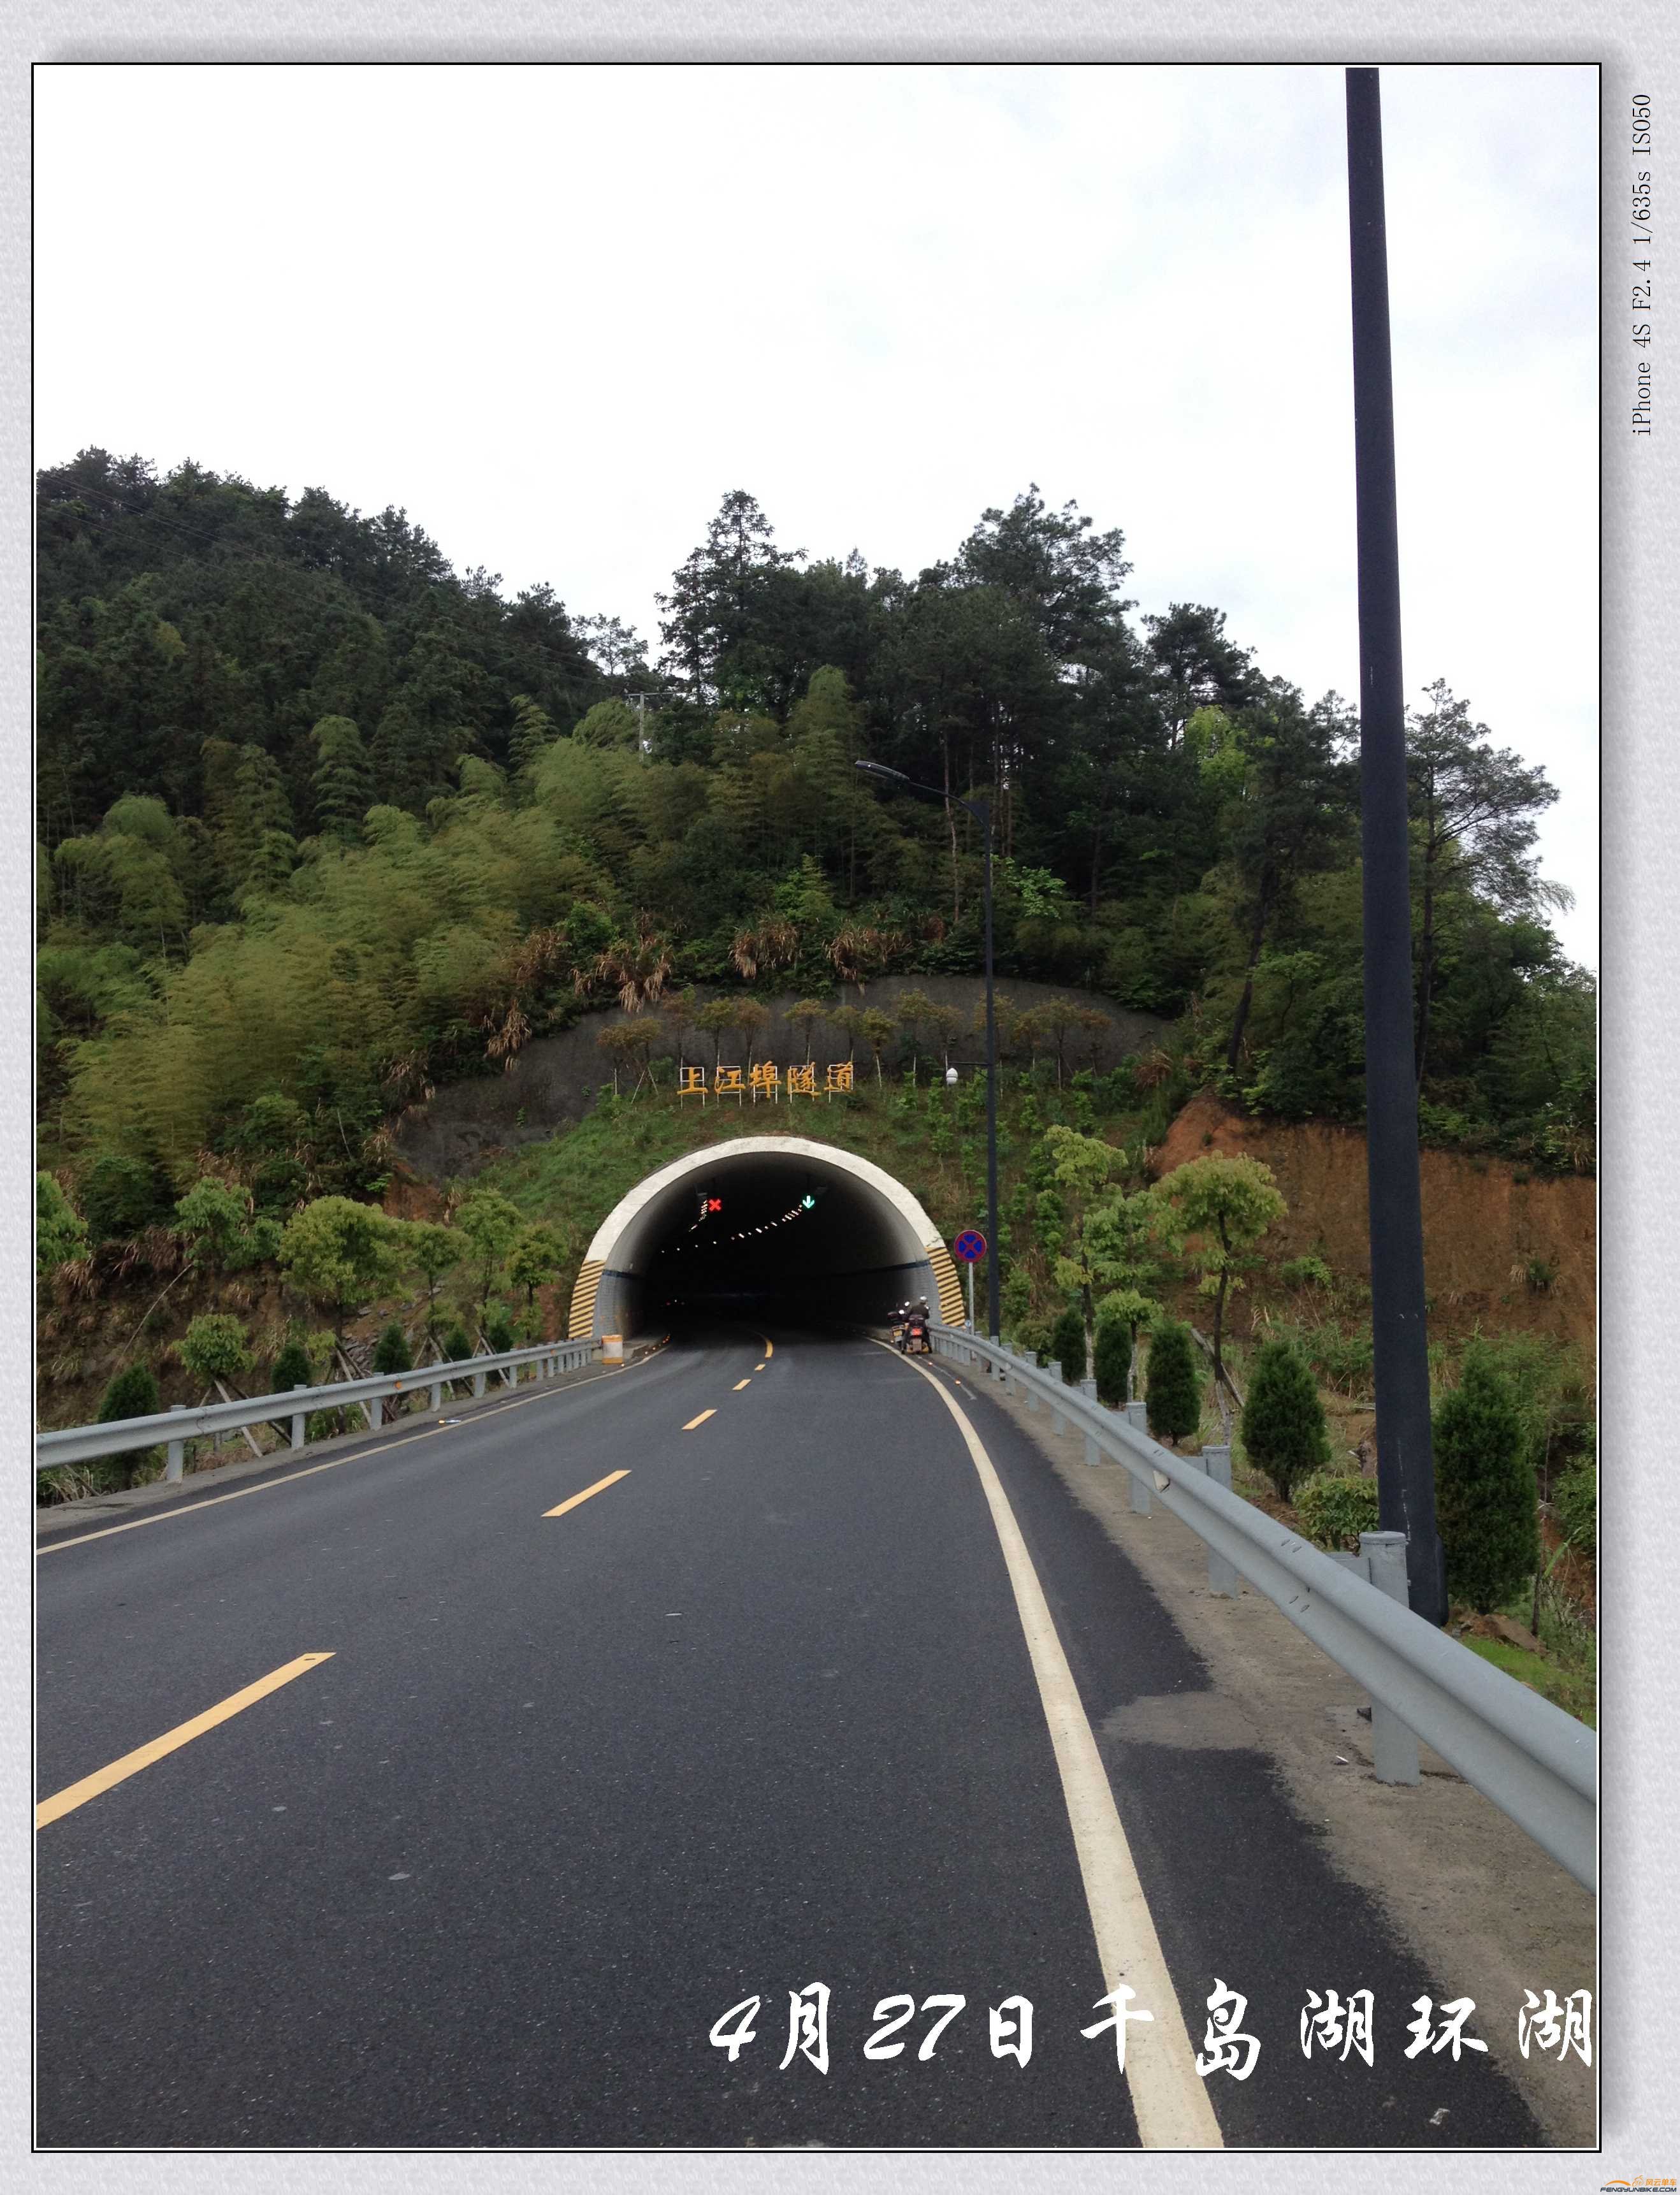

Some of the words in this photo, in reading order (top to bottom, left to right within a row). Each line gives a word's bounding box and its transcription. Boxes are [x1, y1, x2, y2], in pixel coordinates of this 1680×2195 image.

[677, 1061, 853, 1098] 上江埠隧道
